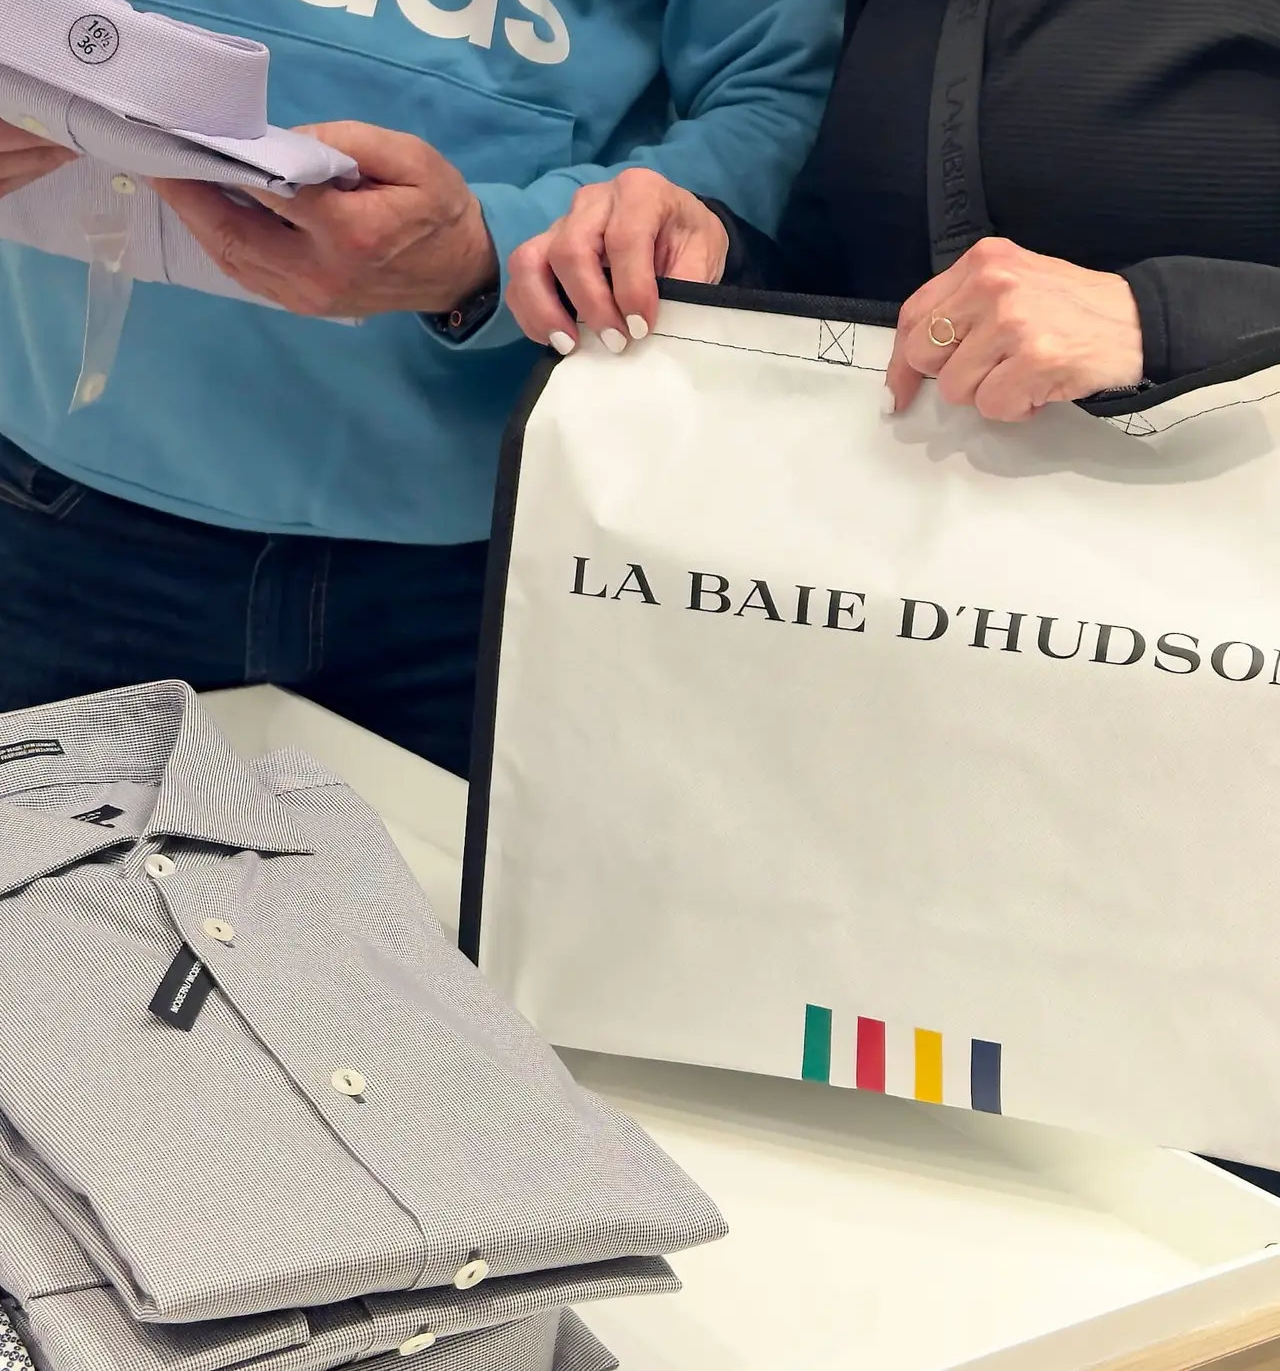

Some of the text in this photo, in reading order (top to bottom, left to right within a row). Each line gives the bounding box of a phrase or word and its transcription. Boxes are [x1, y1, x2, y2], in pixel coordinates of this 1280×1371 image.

[77, 35, 97, 55] 36
[569, 555, 662, 607] LA
[685, 570, 867, 633] BAIE
